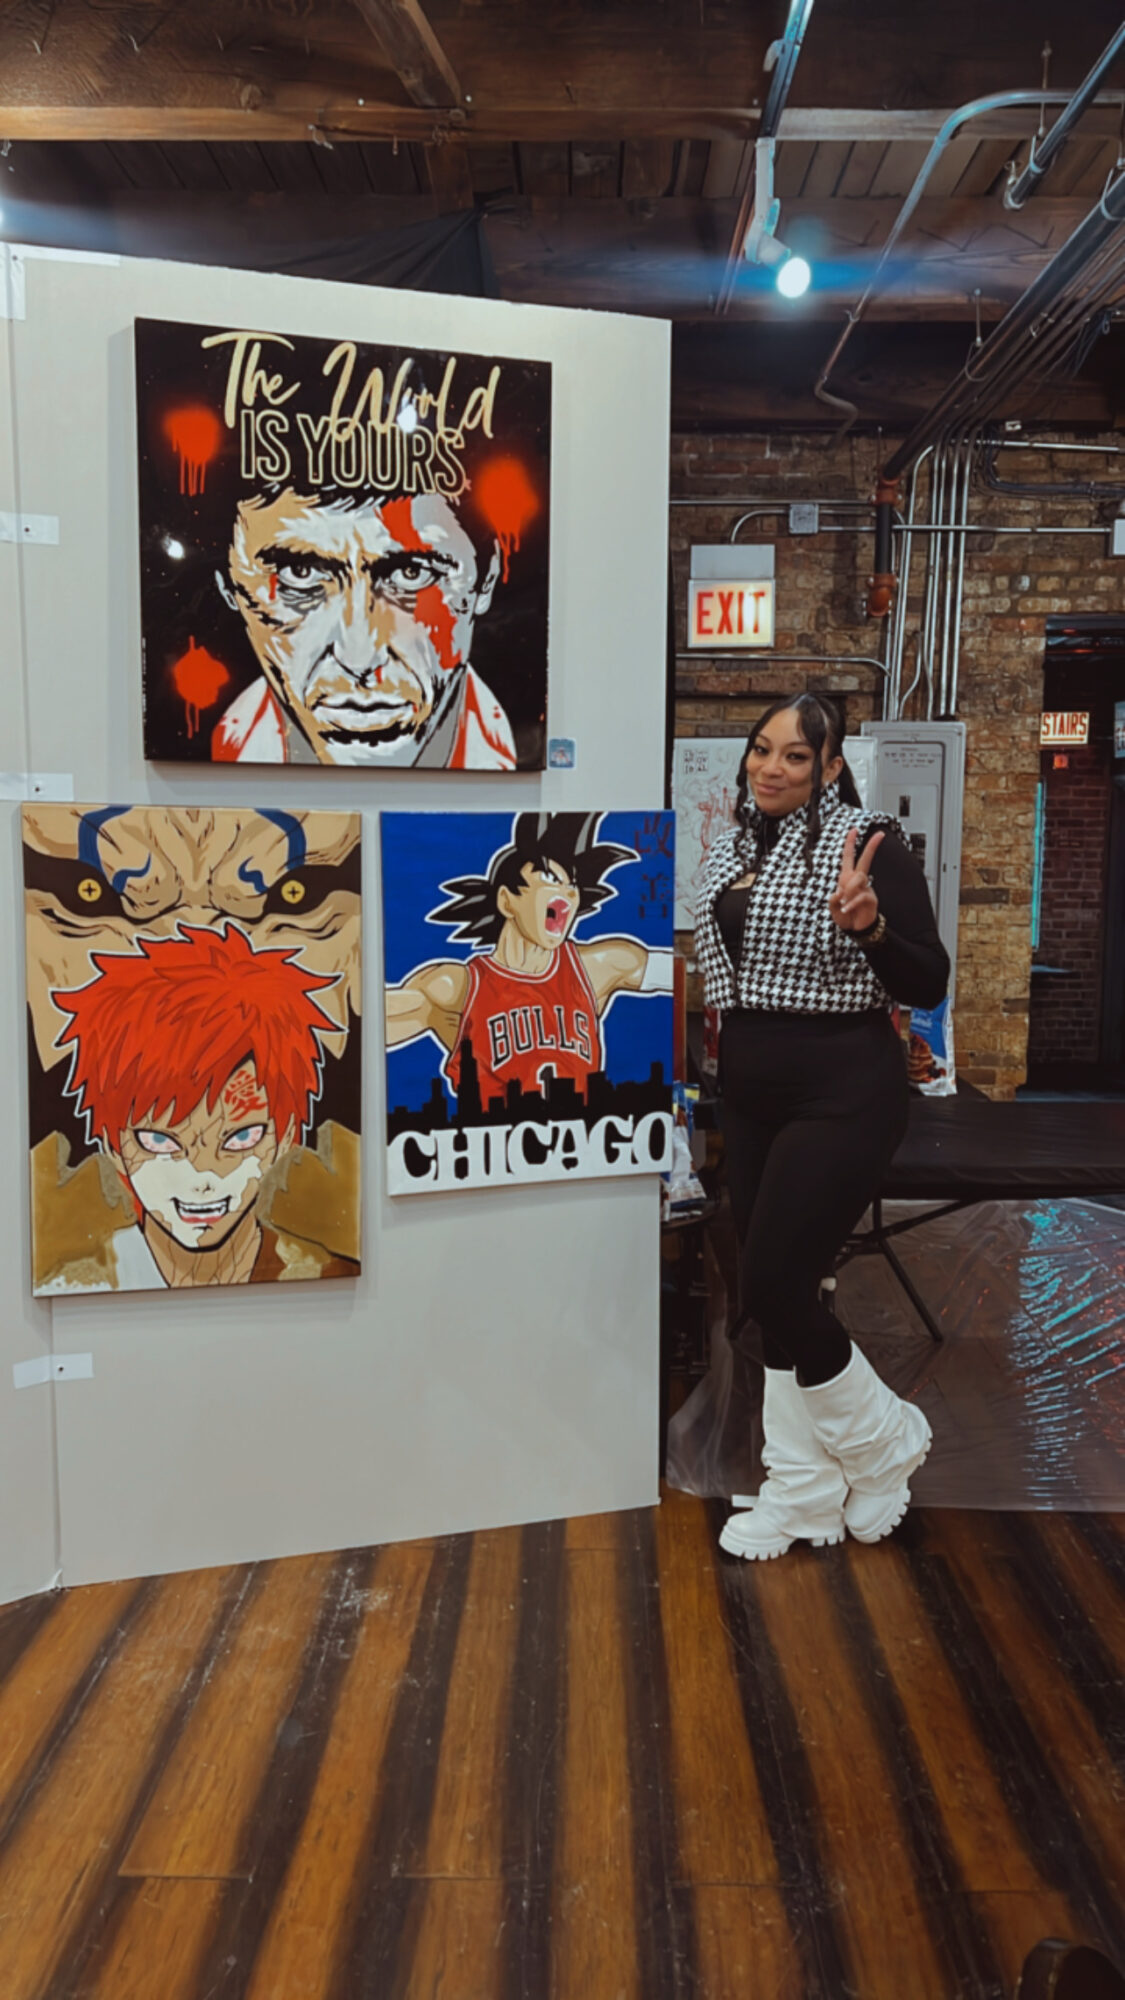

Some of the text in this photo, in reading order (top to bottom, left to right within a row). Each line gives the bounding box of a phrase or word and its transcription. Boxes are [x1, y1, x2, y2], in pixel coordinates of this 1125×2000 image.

[201, 331, 501, 443] The World
[240, 409, 467, 497] IS YOURS
[695, 591, 765, 635] EXIT
[1041, 712, 1087, 736] STAIRS
[487, 1004, 593, 1072] BULLS
[388, 1111, 674, 1184] CHICAGO
